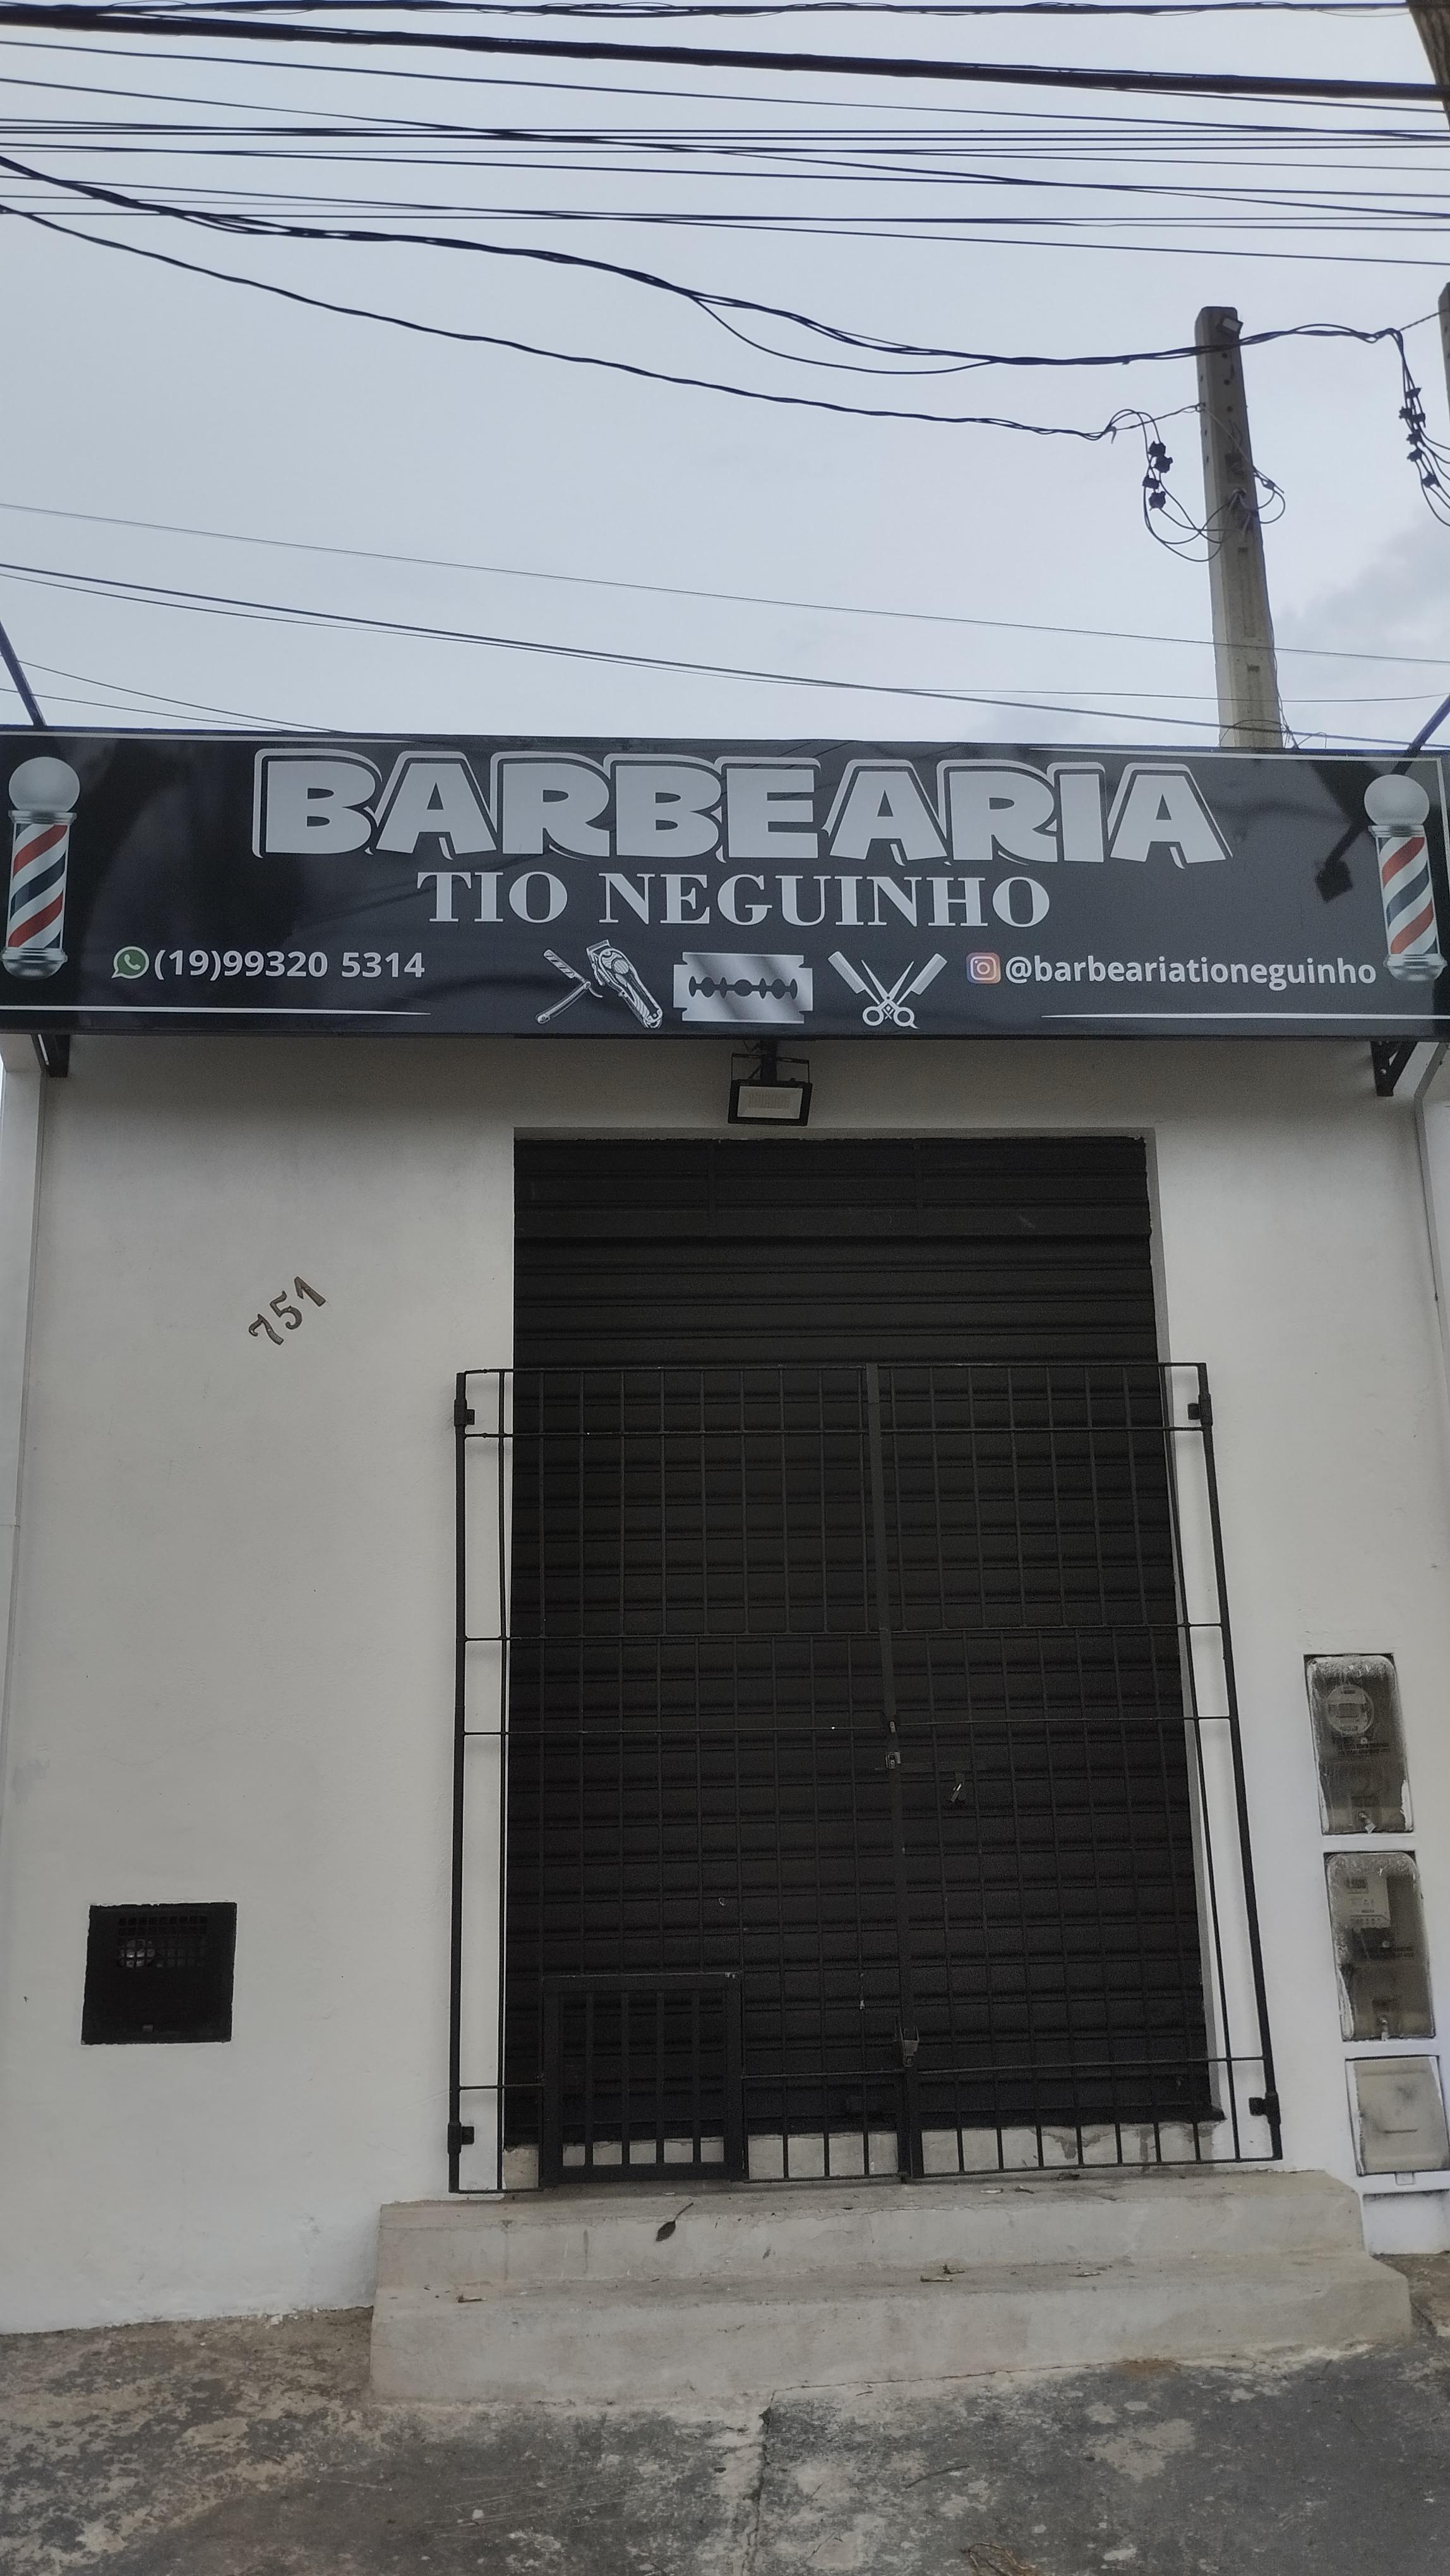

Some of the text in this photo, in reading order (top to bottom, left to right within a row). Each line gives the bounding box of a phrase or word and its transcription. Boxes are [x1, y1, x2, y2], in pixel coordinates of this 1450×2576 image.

[253, 749, 1232, 868] BARBEARIA
[417, 871, 1051, 927] TIO NEGUINHO
[154, 949, 426, 981] (19)99320 5314
[1005, 954, 1377, 991] @barbeariationeguinho
[248, 1276, 327, 1345] 751
